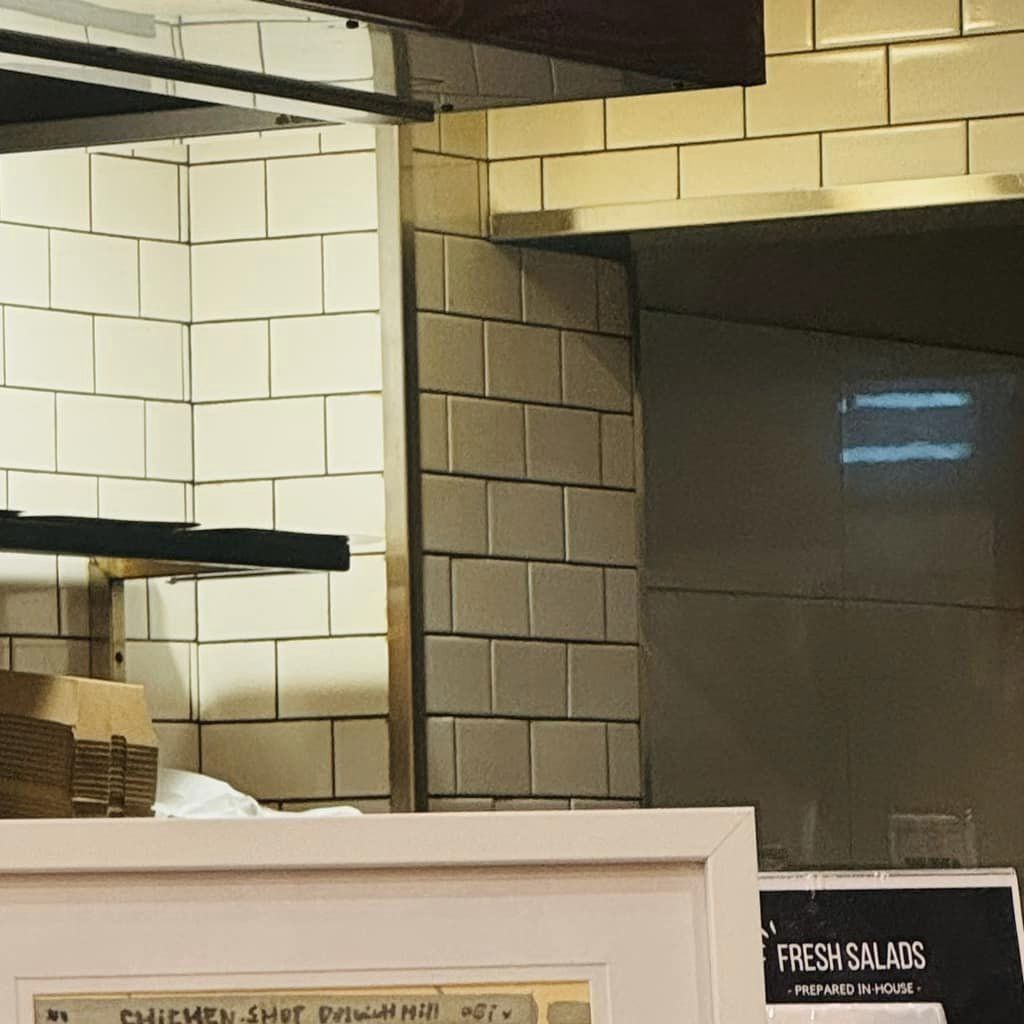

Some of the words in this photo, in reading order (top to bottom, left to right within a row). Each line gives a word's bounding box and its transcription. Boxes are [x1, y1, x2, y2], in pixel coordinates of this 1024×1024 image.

[776, 942, 843, 972] FRESH
[845, 941, 926, 971] SALADS
[794, 983, 855, 996] PREPARED
